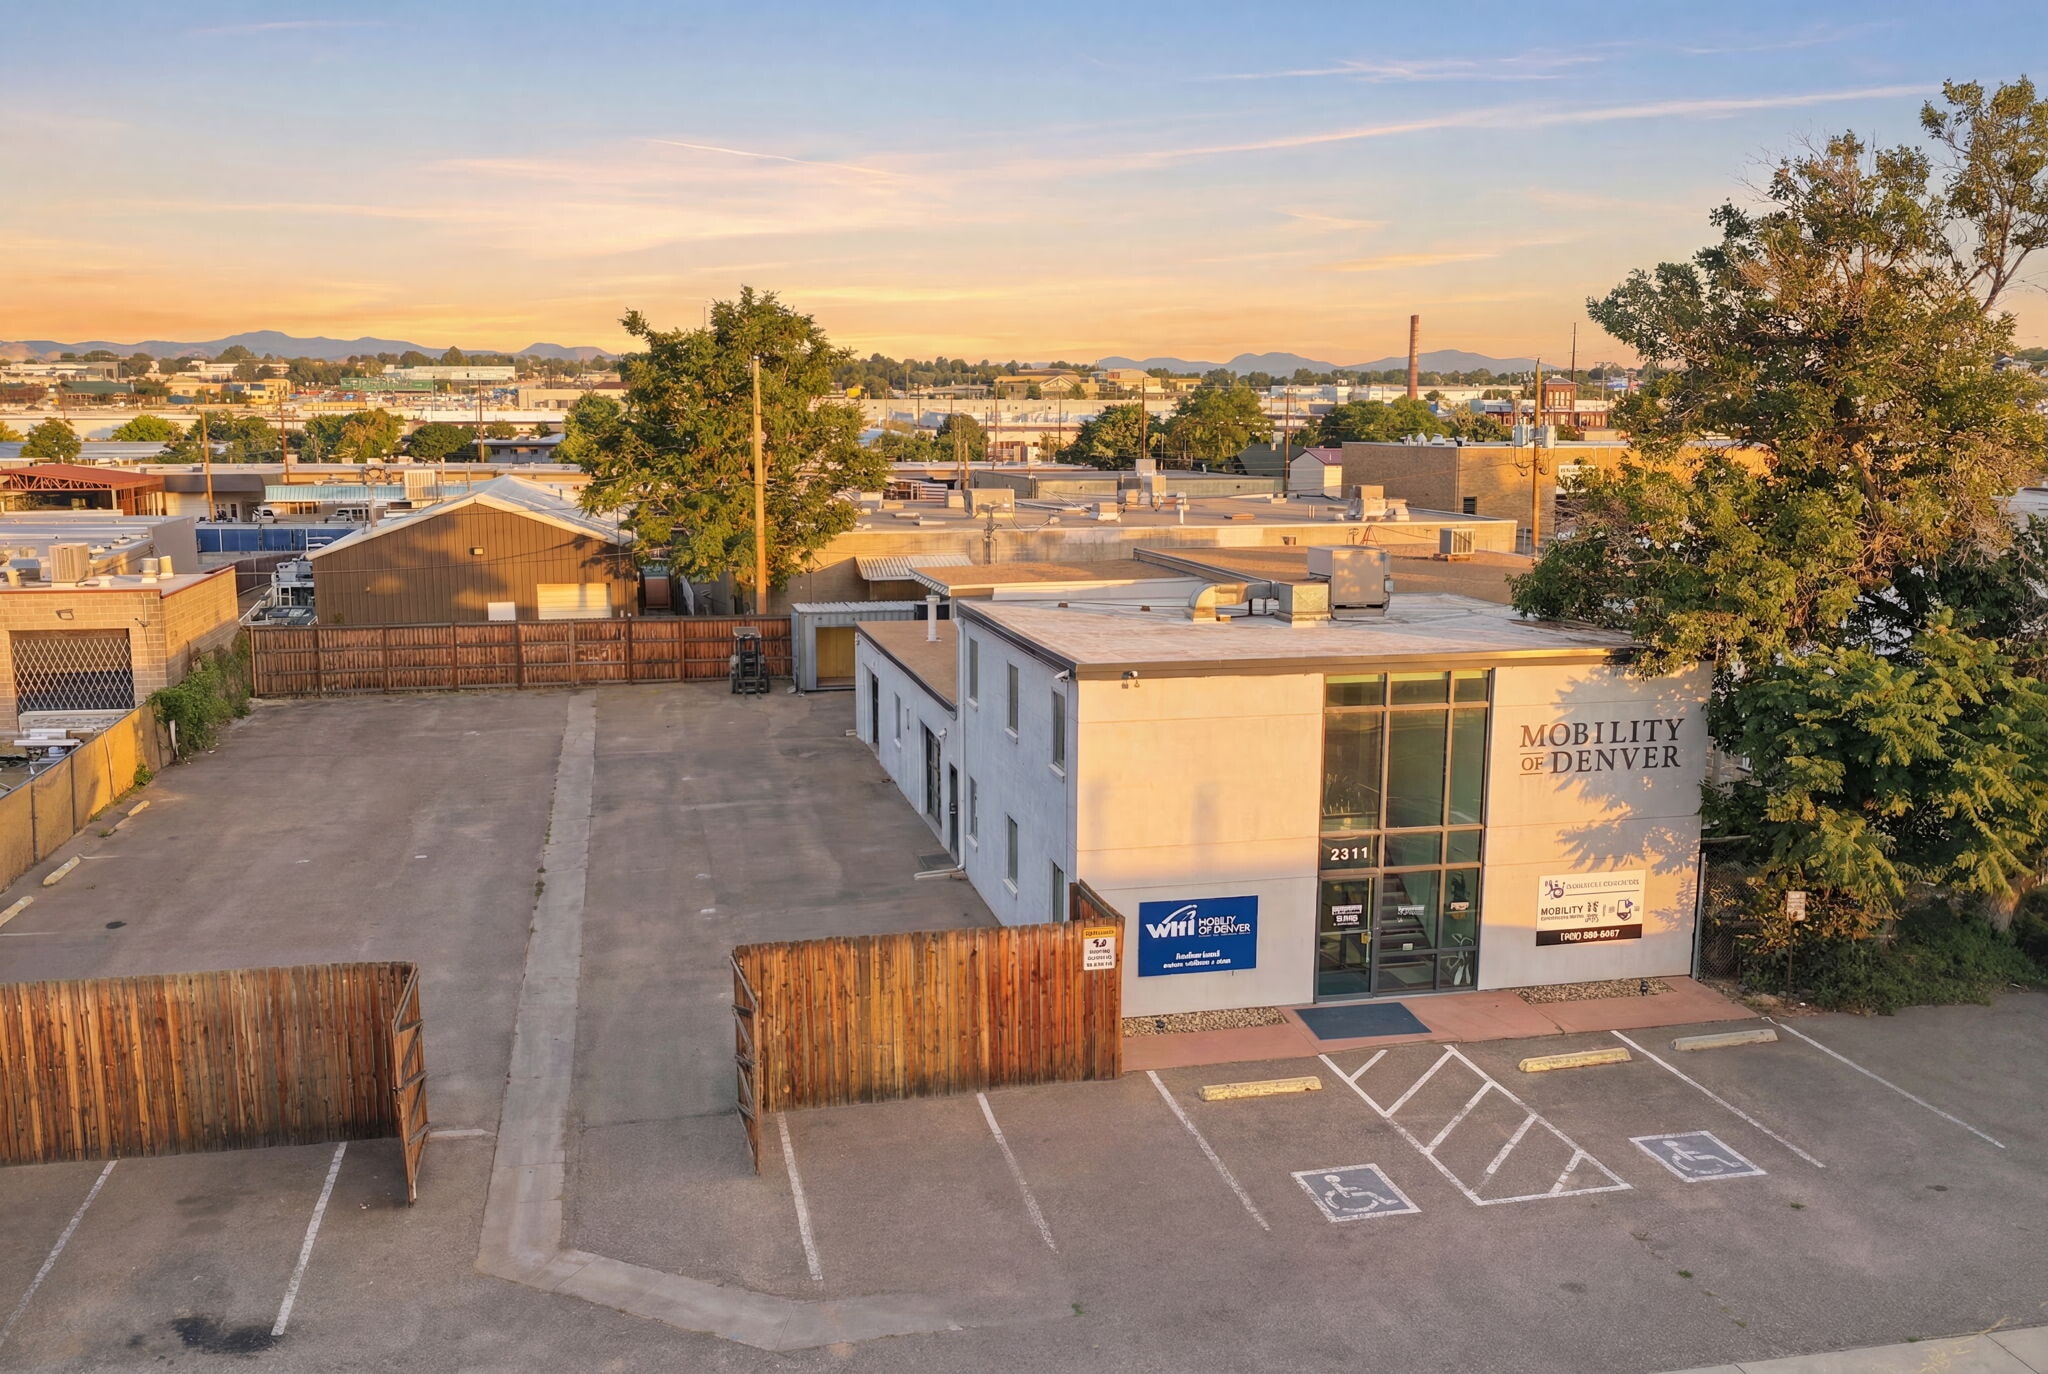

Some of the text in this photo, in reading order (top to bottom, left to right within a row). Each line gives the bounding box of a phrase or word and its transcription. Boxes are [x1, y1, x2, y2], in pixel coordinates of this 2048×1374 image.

[1519, 718, 1685, 748] MOBILITY
[1521, 745, 1681, 774] OF DENVER
[1330, 846, 1368, 861] 2311
[1540, 905, 1584, 916] MOBILITY
[1198, 923, 1251, 935] OF DENVER
